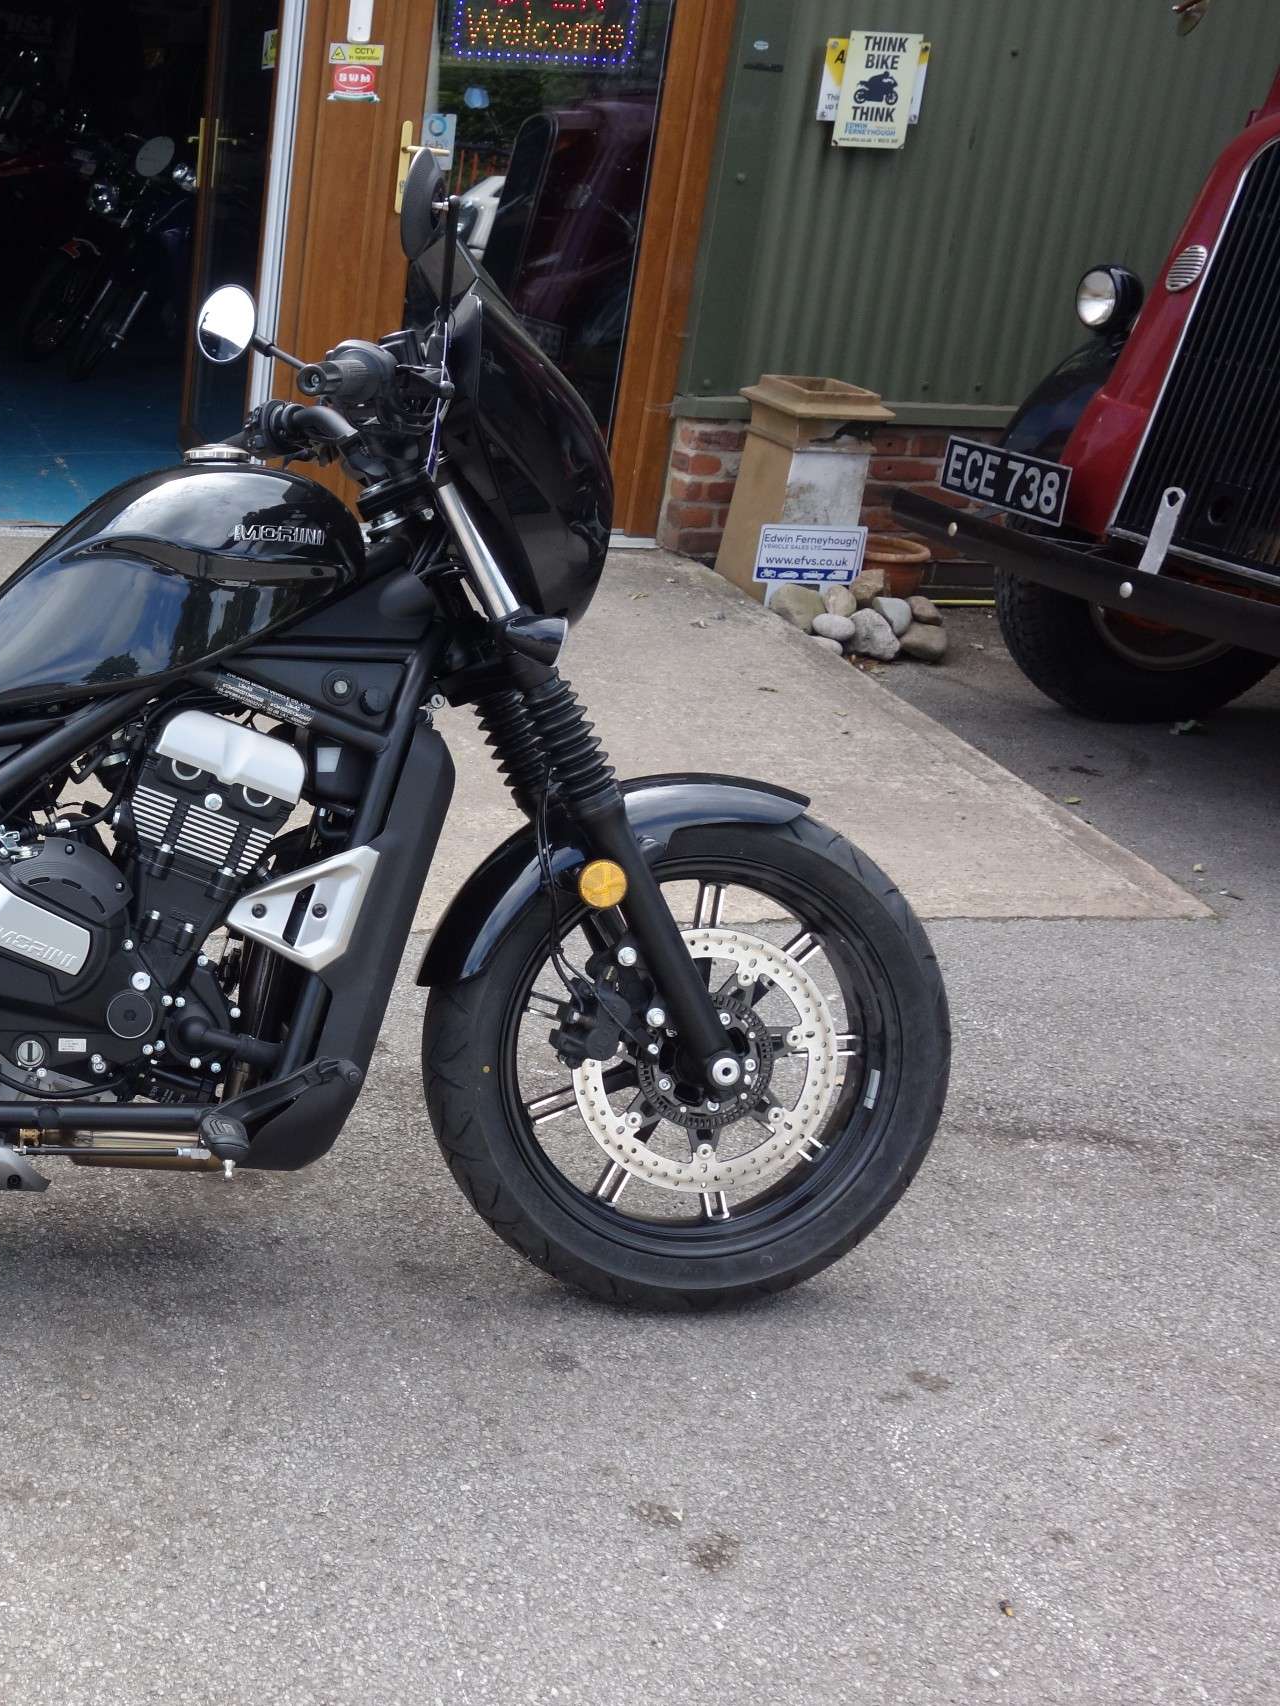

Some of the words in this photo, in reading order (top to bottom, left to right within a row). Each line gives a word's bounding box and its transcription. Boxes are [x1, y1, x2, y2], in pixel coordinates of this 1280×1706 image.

[467, 8, 624, 49] Welcome
[864, 36, 909, 53] THINK
[865, 54, 900, 70] BIKE
[852, 106, 896, 122] THINK
[946, 445, 1001, 497] ECE
[1005, 461, 1060, 514] 738
[764, 533, 793, 543] Edwin
[796, 534, 858, 547] Ferneyhough
[765, 555, 848, 567] www.efvs.co.uk
